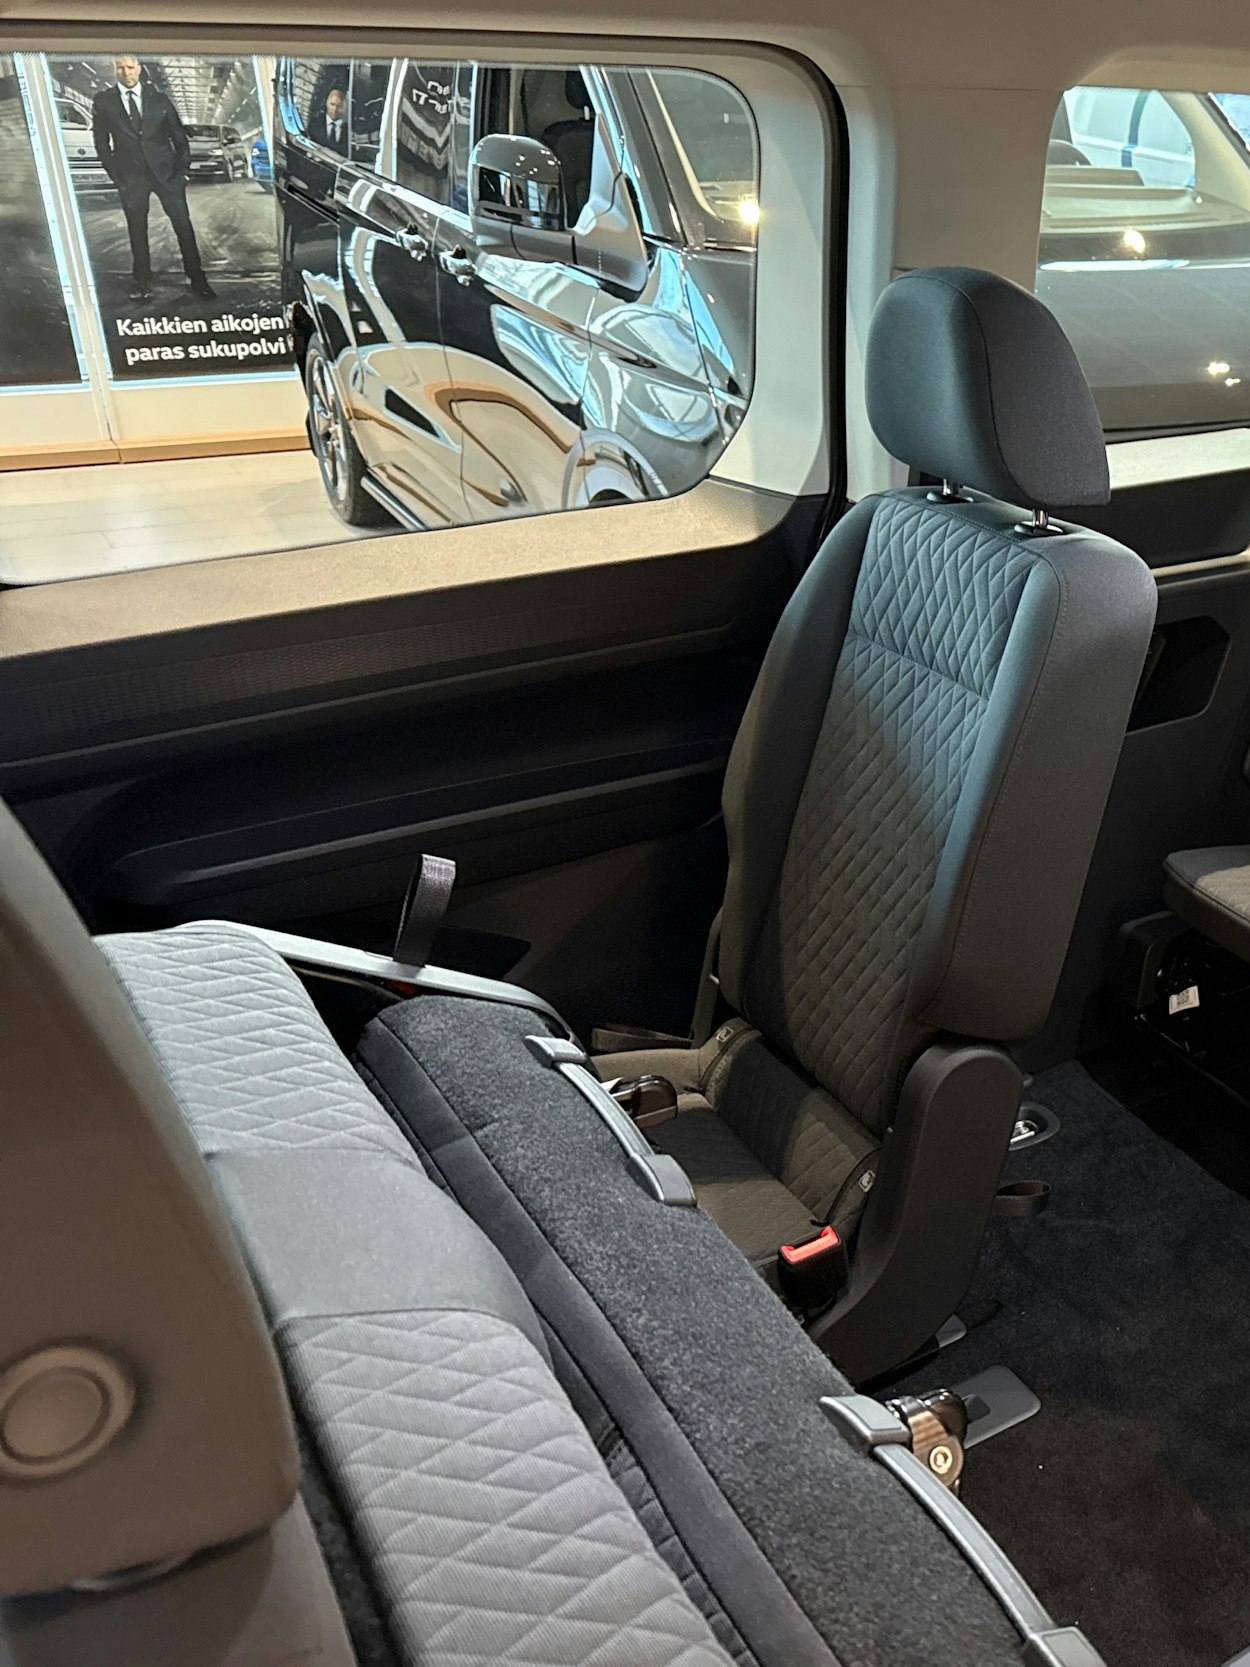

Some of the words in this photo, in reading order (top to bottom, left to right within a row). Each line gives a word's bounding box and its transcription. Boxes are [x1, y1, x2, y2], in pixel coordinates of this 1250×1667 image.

[116, 315, 208, 336] Kaikkien
[211, 313, 284, 335] aikojen
[125, 346, 186, 366] paras
[188, 337, 286, 360] sukupolvi
